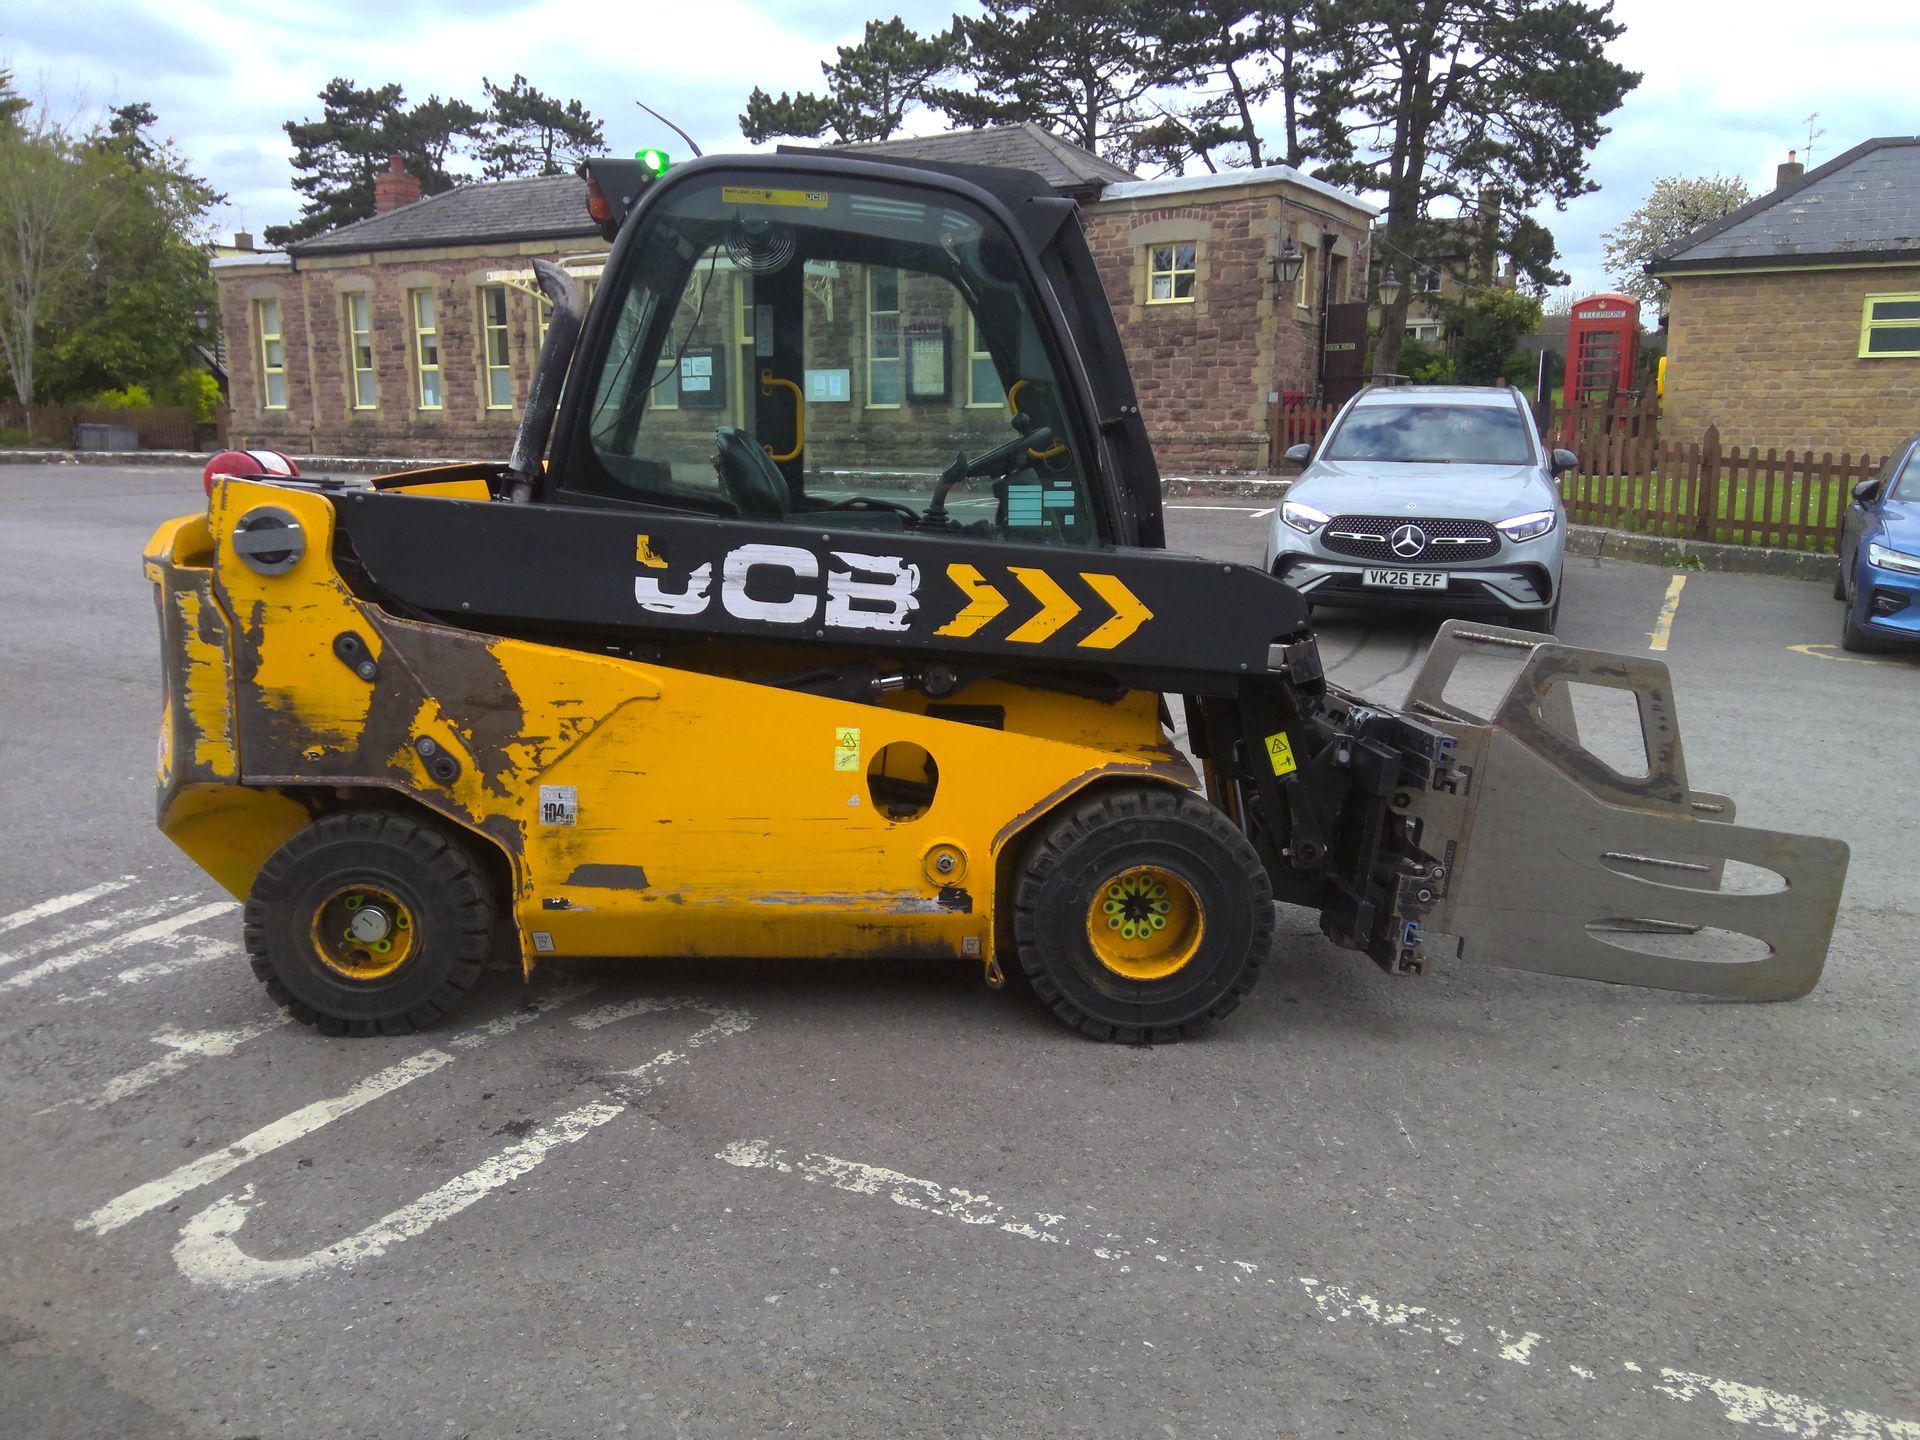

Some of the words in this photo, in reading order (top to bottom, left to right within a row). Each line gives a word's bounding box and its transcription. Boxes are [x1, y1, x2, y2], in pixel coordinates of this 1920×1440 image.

[806, 193, 827, 201] JCB
[634, 543, 920, 631] JCB
[1371, 570, 1408, 585] VK26
[1412, 573, 1442, 587] EZF
[543, 803, 565, 822] 104
